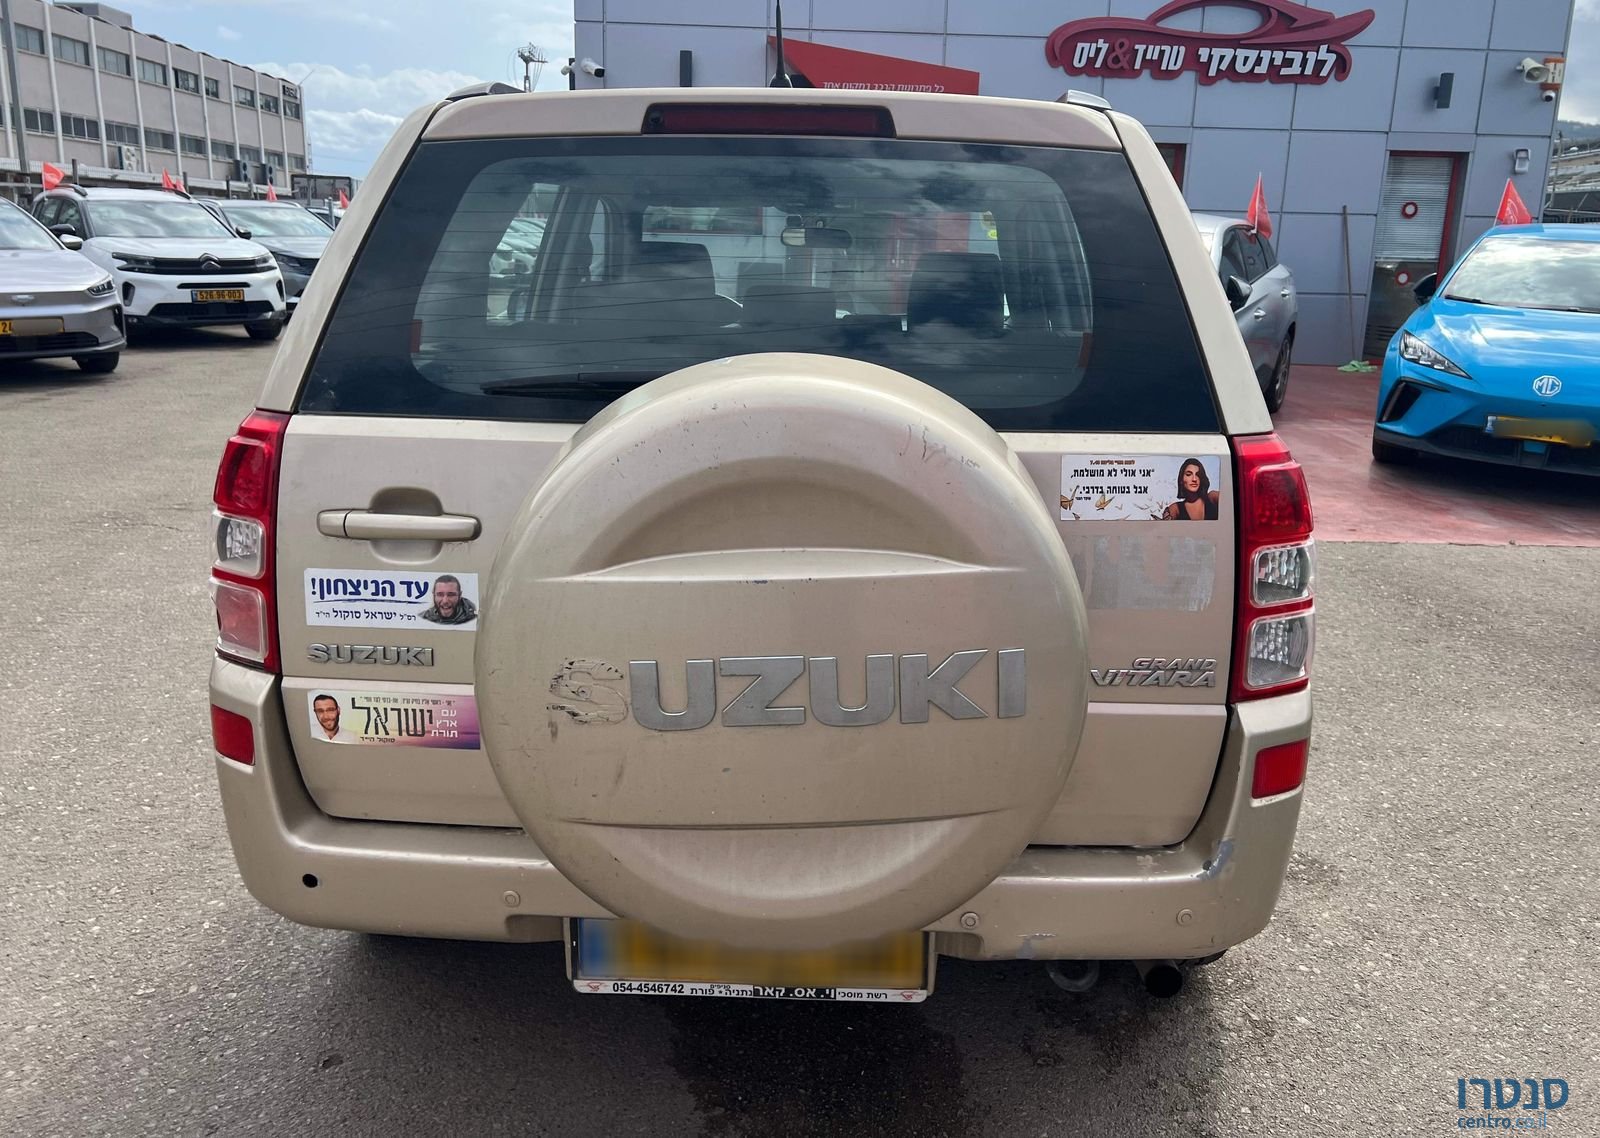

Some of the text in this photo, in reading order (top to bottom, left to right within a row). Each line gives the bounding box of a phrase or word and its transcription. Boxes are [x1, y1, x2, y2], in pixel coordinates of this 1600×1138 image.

[1198, 44, 1337, 77] לובינסקי
[1535, 376, 1561, 395] MG
[1070, 468, 1105, 479] מושלמת,
[1107, 468, 1118, 477] לא
[1120, 468, 1136, 477] אולי
[1106, 485, 1131, 495] בטוחה
[1133, 485, 1148, 495] אבל
[311, 577, 429, 600] עד הניצחון!
[332, 608, 361, 621] סוקול
[364, 609, 397, 620] ישראל
[307, 643, 435, 666] SUZUKI
[1132, 657, 1217, 670] GRAND
[1090, 669, 1217, 688] VITARA
[351, 697, 433, 737] ישראל
[441, 709, 457, 717] עם
[436, 720, 458, 728] ארץ
[430, 729, 458, 738] תורת
[612, 983, 685, 994] 054-4546742
[690, 986, 715, 995] פורת
[754, 986, 785, 998] קאר
[837, 991, 863, 999] מוסכי
[866, 991, 888, 999] רשת
